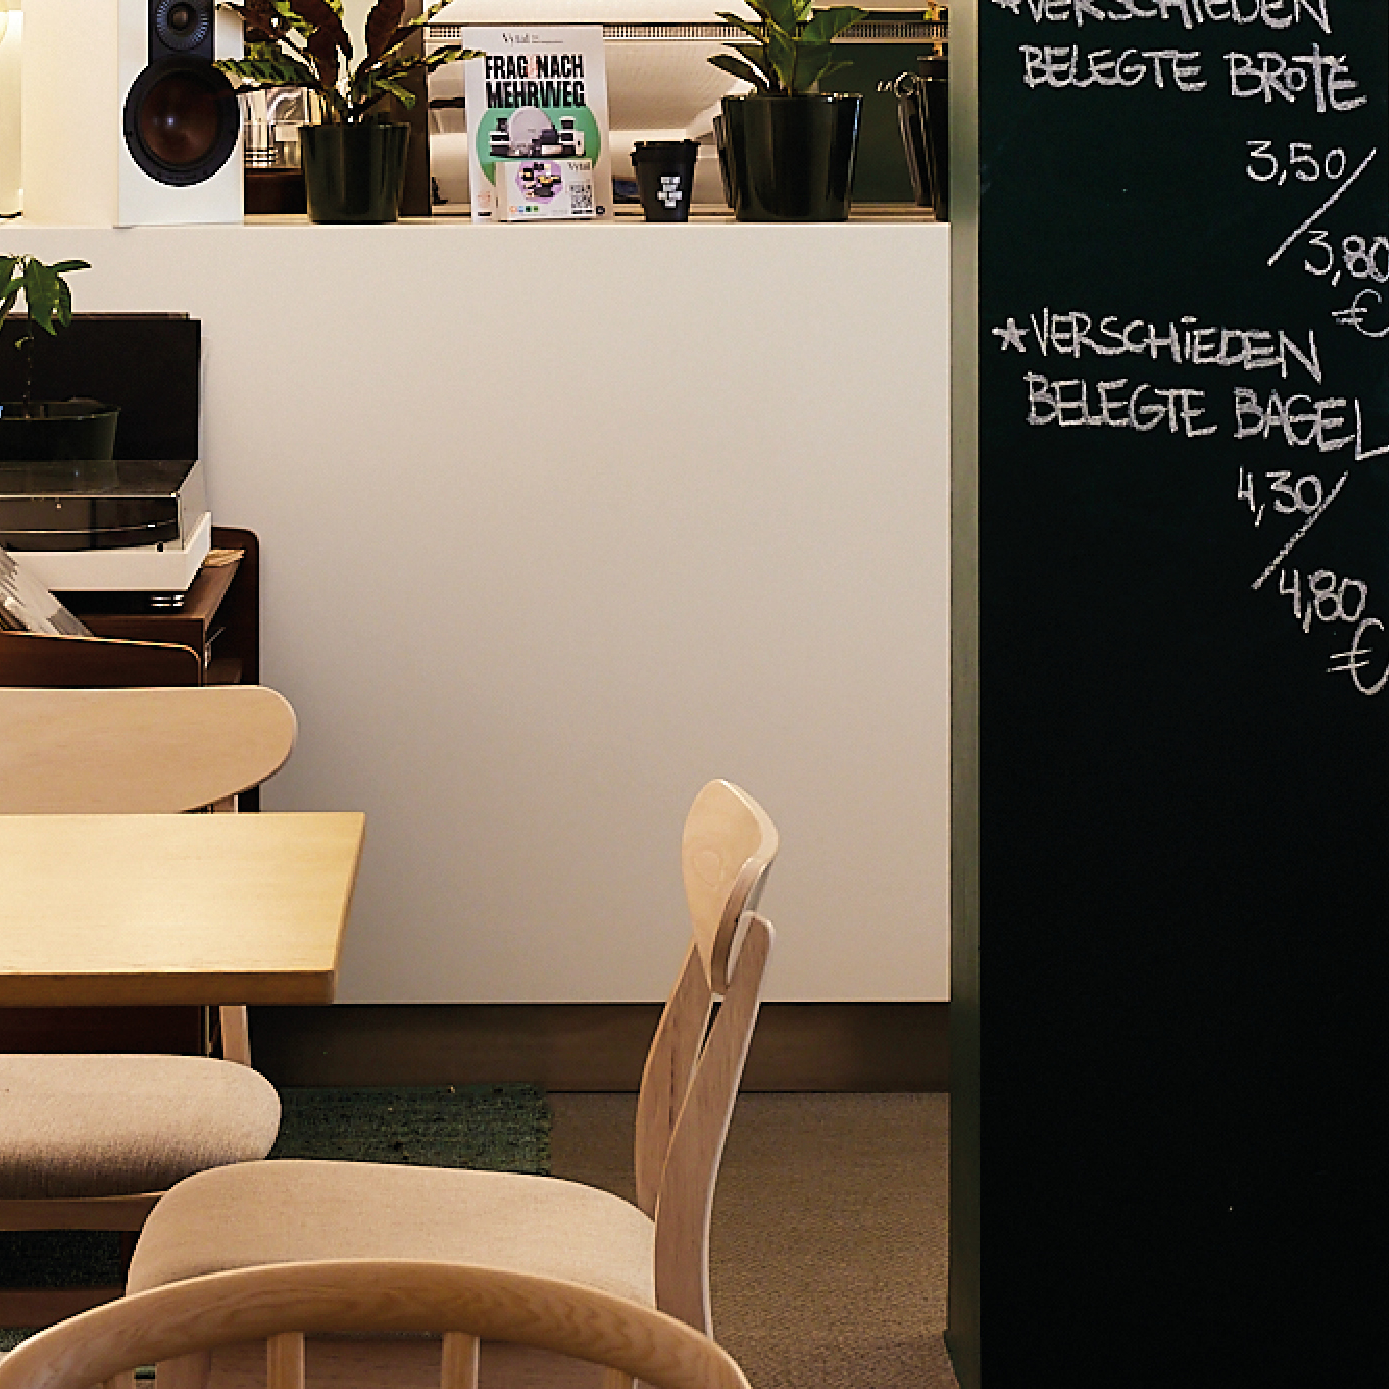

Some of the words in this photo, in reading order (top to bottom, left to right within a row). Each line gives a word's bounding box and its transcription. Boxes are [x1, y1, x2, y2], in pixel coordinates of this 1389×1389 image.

[485, 55, 528, 79] FRAG
[537, 54, 584, 78] NACH
[1019, 45, 1207, 91] BELEGTE
[486, 81, 586, 108] MEHRWEG
[1023, 372, 1217, 437] BELEGTE
[1234, 387, 1389, 460] BAGEL
